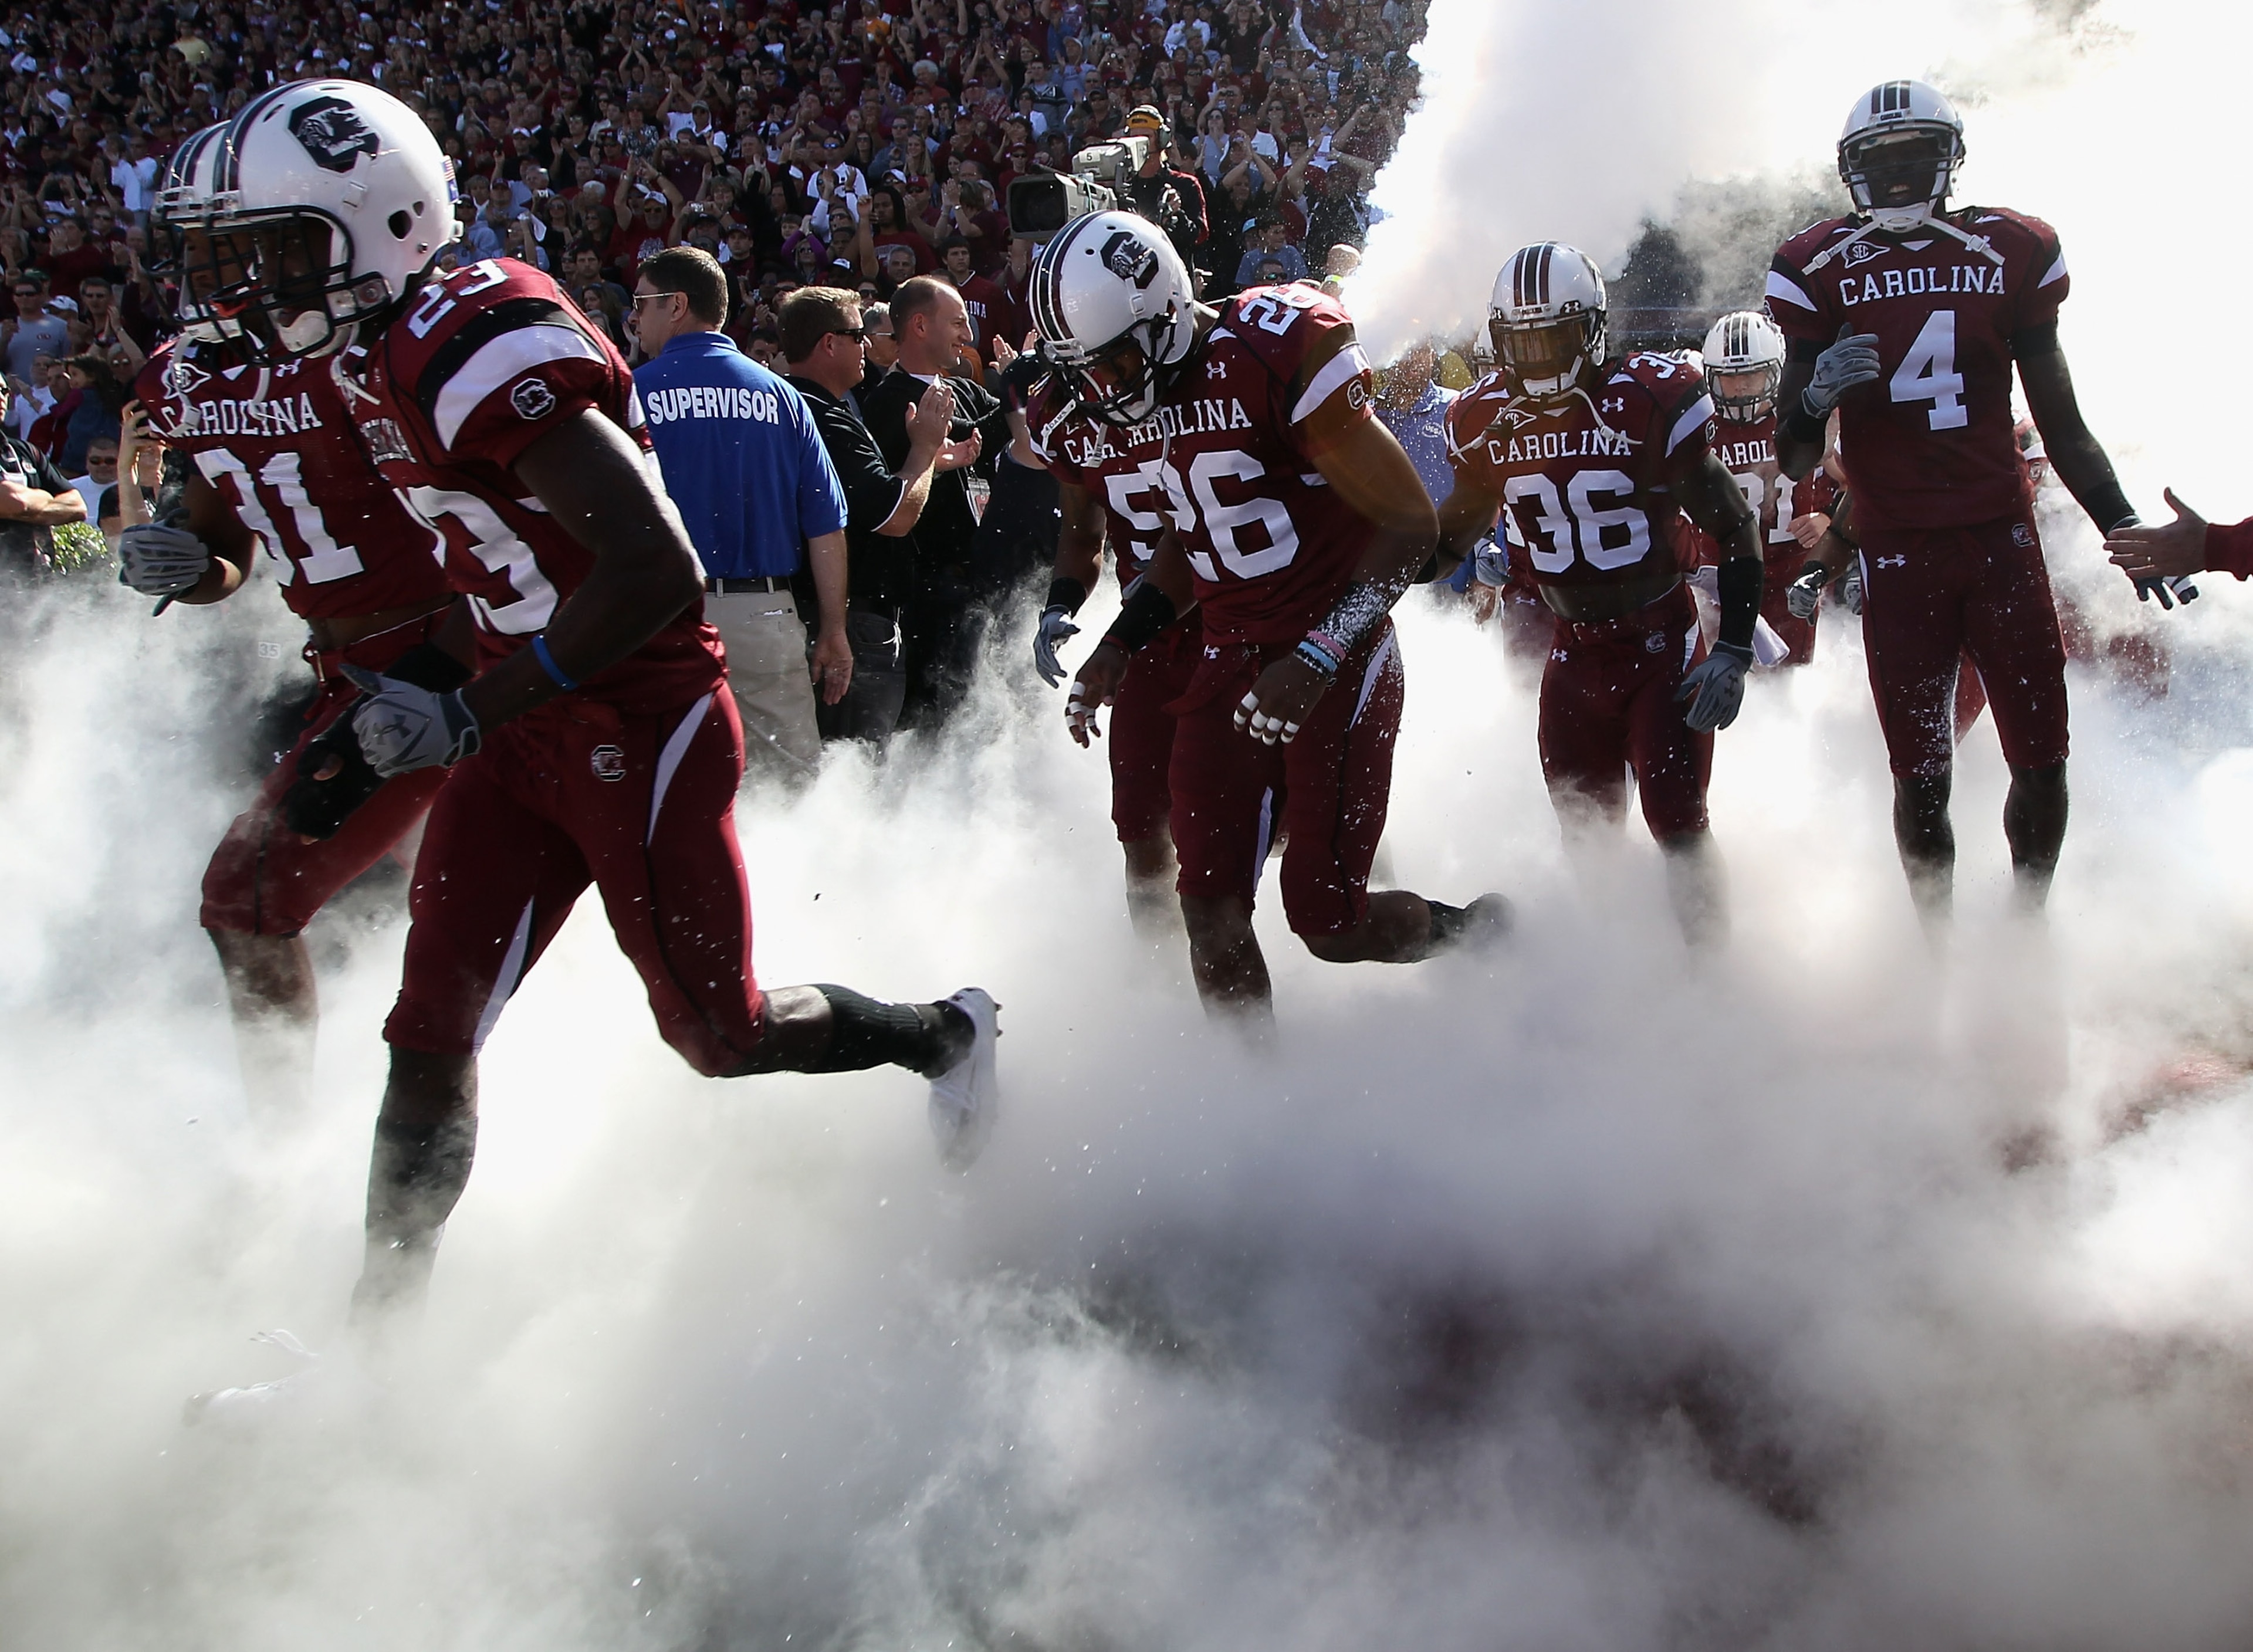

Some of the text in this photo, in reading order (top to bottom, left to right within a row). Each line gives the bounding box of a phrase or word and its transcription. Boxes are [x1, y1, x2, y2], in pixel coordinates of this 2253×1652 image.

[1086, 153, 1092, 161] 5
[1852, 244, 1869, 259] SEC
[1839, 265, 2005, 306] CAROLINA
[1889, 310, 1968, 431] 4
[647, 387, 779, 425] SUPERVISOR
[1487, 428, 1632, 465] CAROLINA
[1503, 469, 1652, 574] 36
[259, 643, 279, 657] 35
